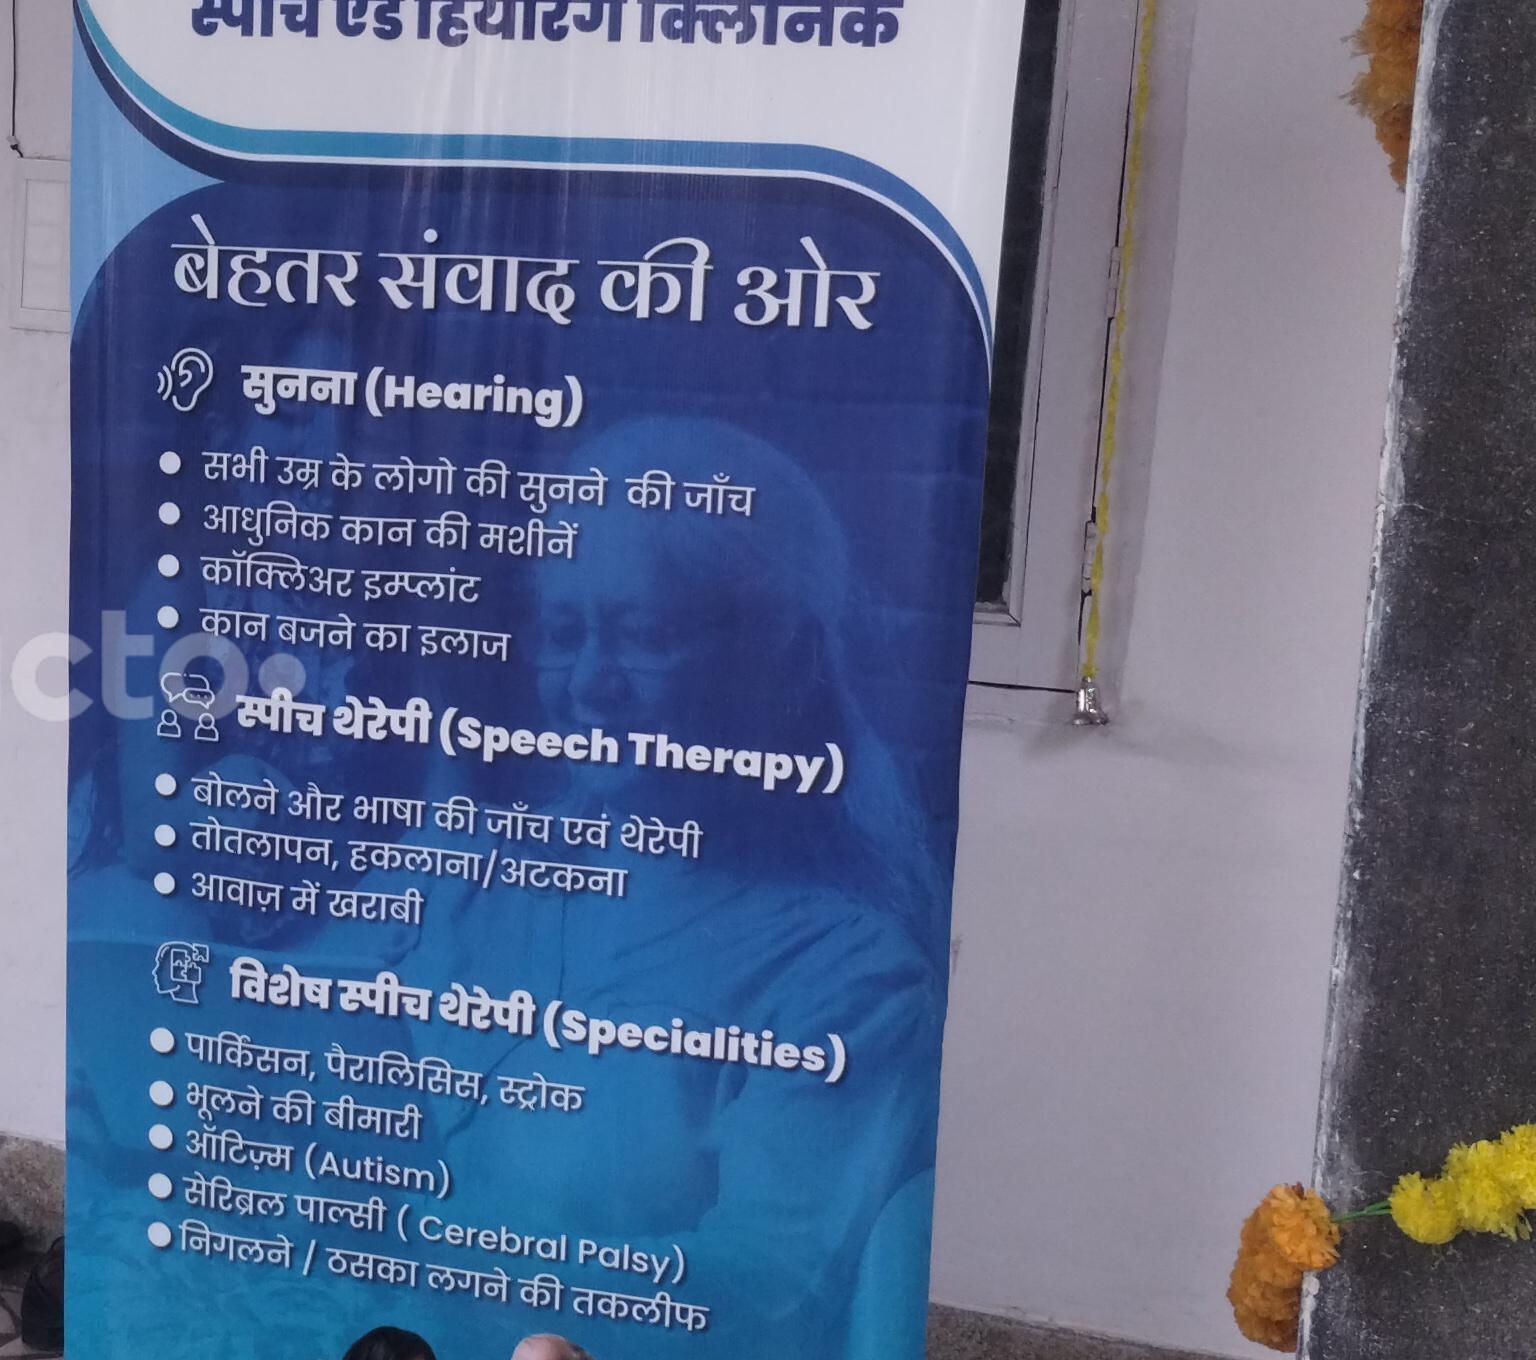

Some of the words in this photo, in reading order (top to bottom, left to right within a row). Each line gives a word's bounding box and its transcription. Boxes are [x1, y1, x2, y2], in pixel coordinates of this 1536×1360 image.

[171, 214, 362, 307] बेहतर
[378, 228, 579, 324] संवाद
[597, 237, 714, 321] की
[734, 236, 881, 330] ओर
[241, 365, 357, 414] सुनना
[366, 367, 582, 427] (Hearing)
[202, 446, 268, 483] सभी
[275, 456, 323, 490] उम्र
[329, 453, 365, 490] के
[372, 455, 457, 494] लोगो
[464, 459, 511, 499] की
[517, 467, 608, 514] सुनने
[625, 469, 675, 511] की
[683, 472, 756, 517] जाँच
[203, 500, 333, 547] आधुनिक
[339, 515, 416, 547] कान
[423, 510, 471, 550] की
[478, 518, 579, 559] मशीनें
[200, 550, 354, 597] कॉक्लिअर
[361, 566, 481, 603] इम्प्लांट
[199, 608, 270, 641] कान
[276, 614, 356, 650] बजने
[363, 622, 411, 652] का
[417, 625, 511, 662] इलाज
[236, 688, 326, 737] स्पीच
[333, 696, 431, 745] थेरेपी
[439, 707, 621, 764] (Speech
[629, 730, 846, 794] Therapy)
[189, 816, 339, 871] तोतलापन,
[191, 771, 279, 815] बोलने
[288, 782, 344, 821] और
[353, 795, 426, 828] भाषा
[432, 796, 478, 835] की
[486, 800, 550, 843] जाँच
[563, 812, 610, 849] एवं
[619, 819, 703, 860] थेरेपी
[191, 872, 284, 913] आवाज़
[290, 880, 321, 915] में
[327, 888, 424, 925] खराबी
[230, 956, 331, 1010] विशेष
[339, 971, 431, 1021] स्पीच
[439, 982, 536, 1037] थेरेपी
[543, 1000, 848, 1083] (Specialities)
[324, 1043, 490, 1105] पैरालिसिस,
[497, 1072, 586, 1112] स्ट्रोक
[186, 1082, 264, 1122] भूलने
[270, 1090, 316, 1127] की
[322, 1095, 423, 1140] बीमारी
[304, 1142, 453, 1200] (Autism)
[182, 1171, 286, 1217] सेरिब्रल
[294, 1193, 388, 1233] पाल्सी
[577, 1243, 689, 1287] Palsy)
[178, 1218, 294, 1268] निगलने
[325, 1248, 421, 1288] ठसका
[426, 1262, 512, 1303] लगने
[518, 1272, 566, 1311] की
[571, 1283, 710, 1333] तकलीफ
